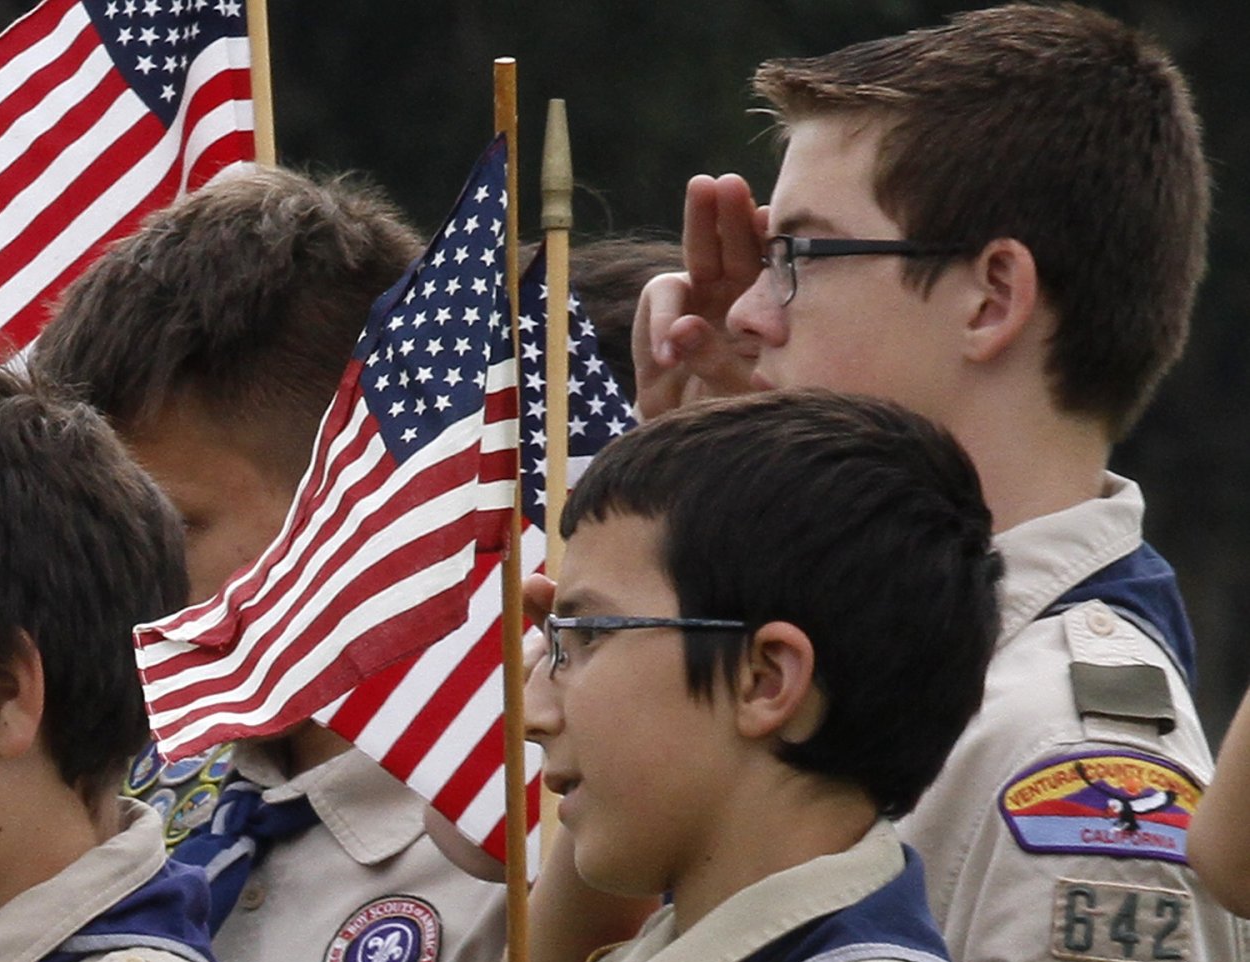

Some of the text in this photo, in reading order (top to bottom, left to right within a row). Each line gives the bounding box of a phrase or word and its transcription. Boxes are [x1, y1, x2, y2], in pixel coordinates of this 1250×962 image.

[1009, 767, 1081, 807] VENTURA
[1080, 827, 1176, 849] CALIFORNIA
[1063, 887, 1184, 960] 642
